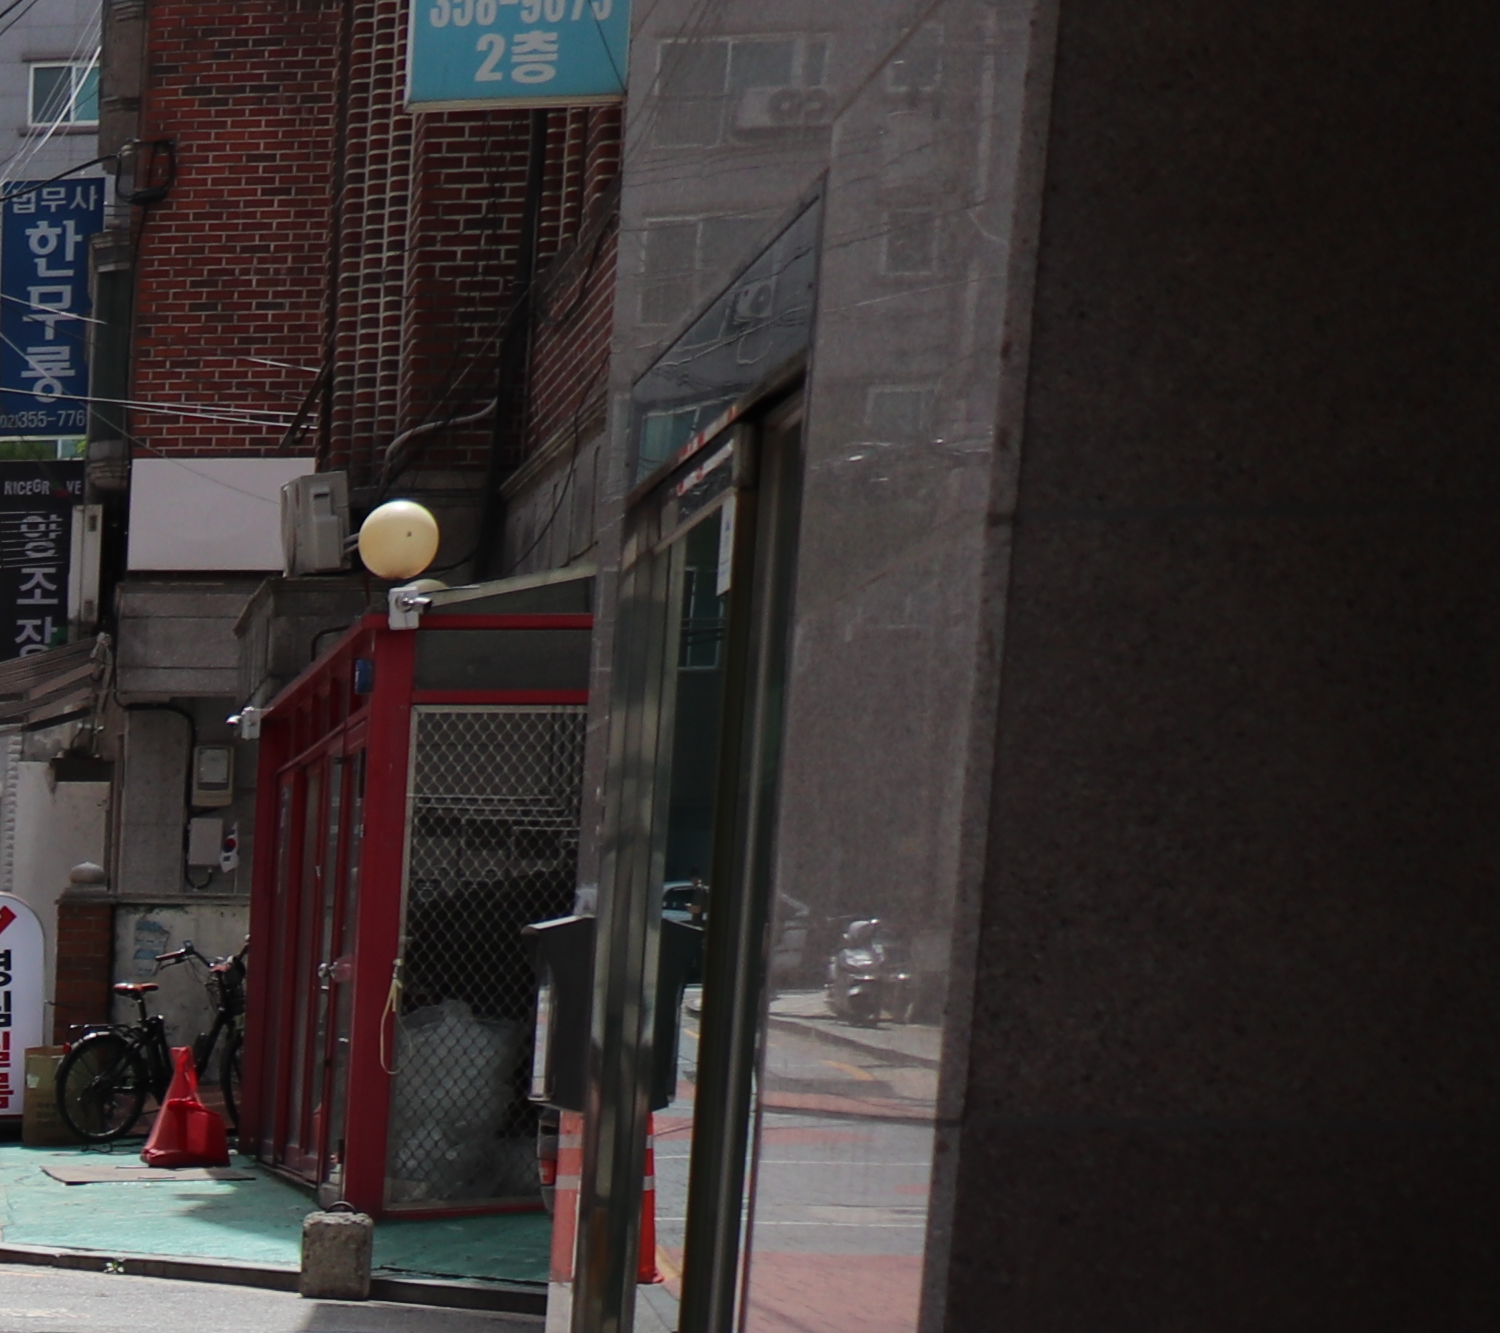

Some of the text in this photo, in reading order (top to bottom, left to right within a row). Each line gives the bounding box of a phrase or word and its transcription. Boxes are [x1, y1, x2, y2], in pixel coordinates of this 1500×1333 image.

[474, 30, 558, 84] 2층
[11, 184, 99, 214] 법무사
[20, 219, 83, 404] 한무룡
[14, 513, 64, 658] 양조장
